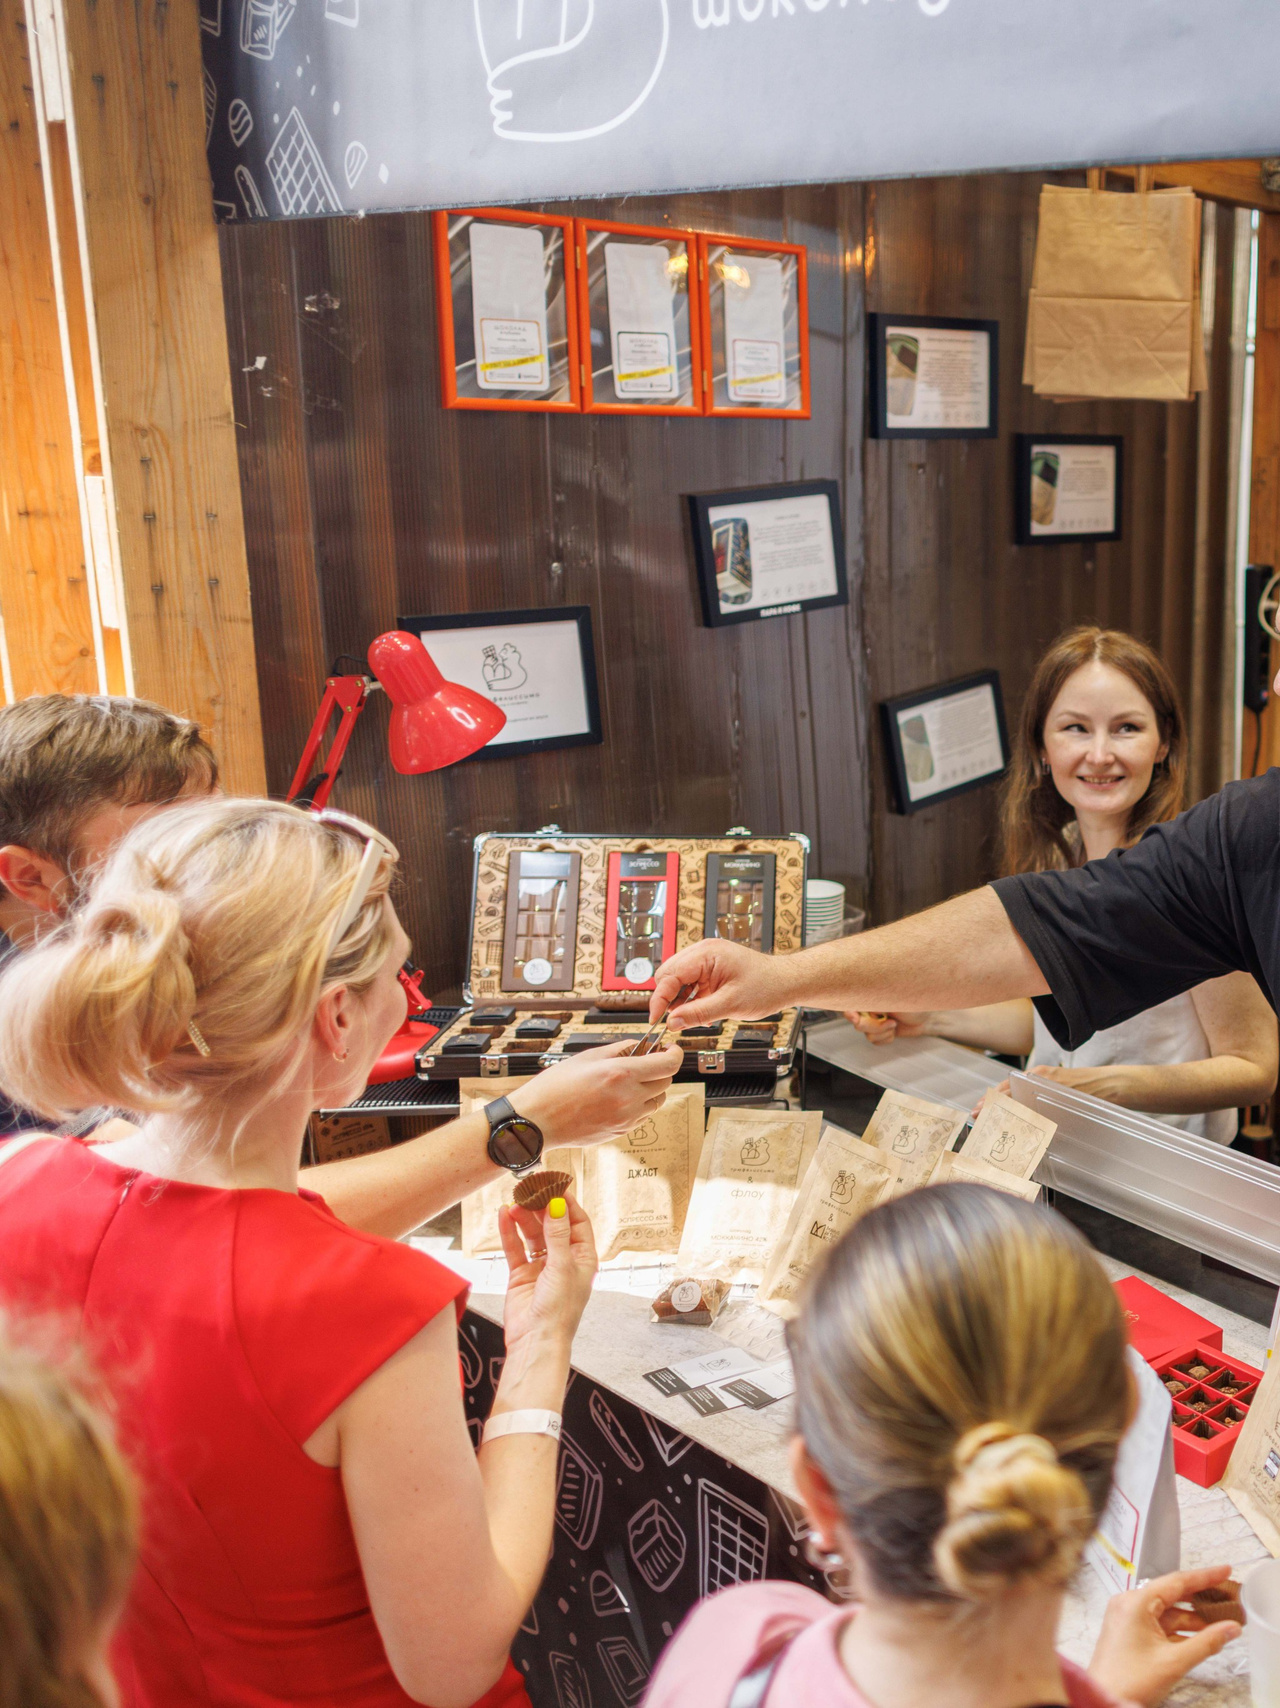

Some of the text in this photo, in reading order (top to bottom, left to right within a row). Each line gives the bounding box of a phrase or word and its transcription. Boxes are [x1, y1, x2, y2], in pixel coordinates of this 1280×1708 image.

[639, 1156, 647, 1165] &
[627, 1167, 659, 1180] ДЖАСТ
[746, 1176, 754, 1184] &
[730, 1188, 765, 1200] флоу
[827, 1213, 834, 1222] &
